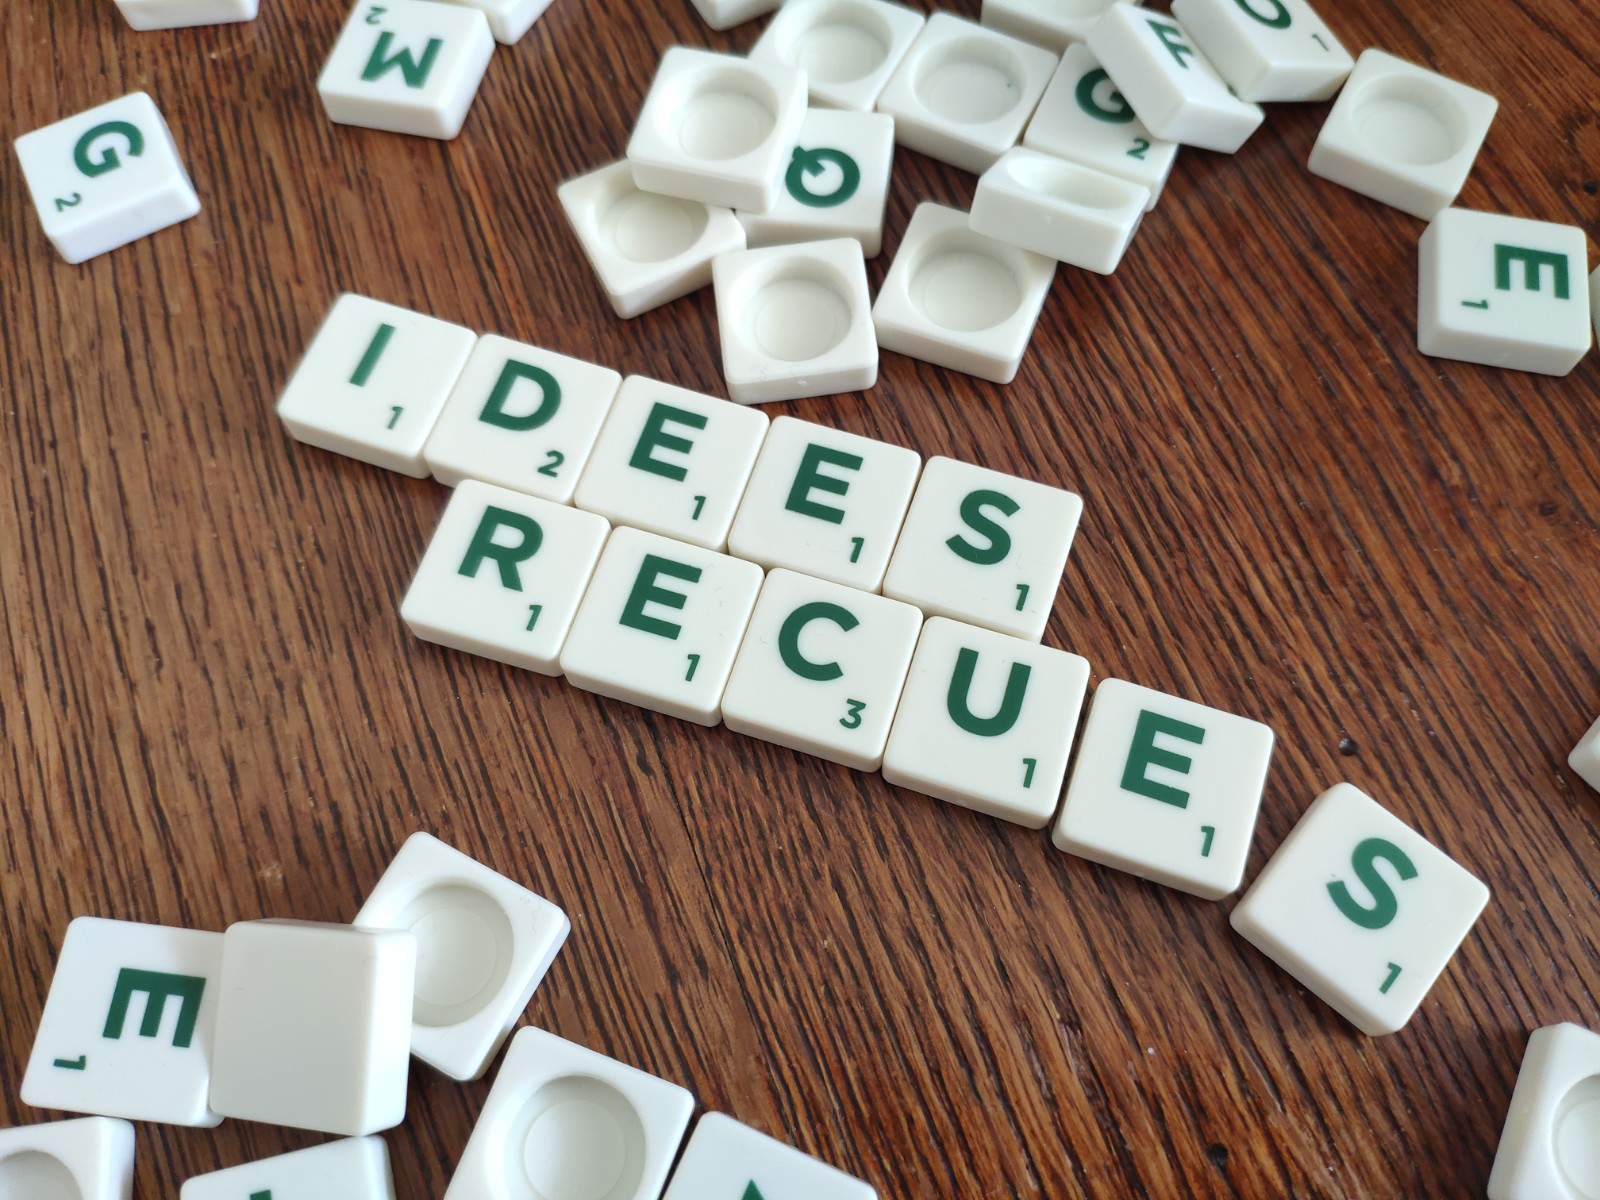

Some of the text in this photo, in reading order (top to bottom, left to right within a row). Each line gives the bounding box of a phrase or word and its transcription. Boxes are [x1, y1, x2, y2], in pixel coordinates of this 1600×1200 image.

[362, 6, 390, 27] 2
[1311, 32, 1329, 52] 1
[359, 29, 446, 90] M
[1074, 67, 1137, 125] G
[72, 120, 147, 179] G
[1125, 137, 1152, 162] 2
[783, 144, 862, 209] Q
[53, 191, 83, 214] 2
[1492, 242, 1571, 301] E
[1460, 298, 1490, 311] 1
[385, 404, 403, 430] 1
[536, 449, 565, 478] 2
[690, 494, 708, 522] 1
[848, 536, 866, 565] 1
[1013, 581, 1032, 613] 1
[524, 603, 544, 633] 1
[683, 652, 702, 684] 1
[838, 699, 869, 731] 3
[1022, 757, 1038, 789] 1
[1200, 824, 1216, 858] 1
[1378, 960, 1404, 996] 1
[102, 966, 206, 1049] E
[53, 1055, 86, 1072] 1
